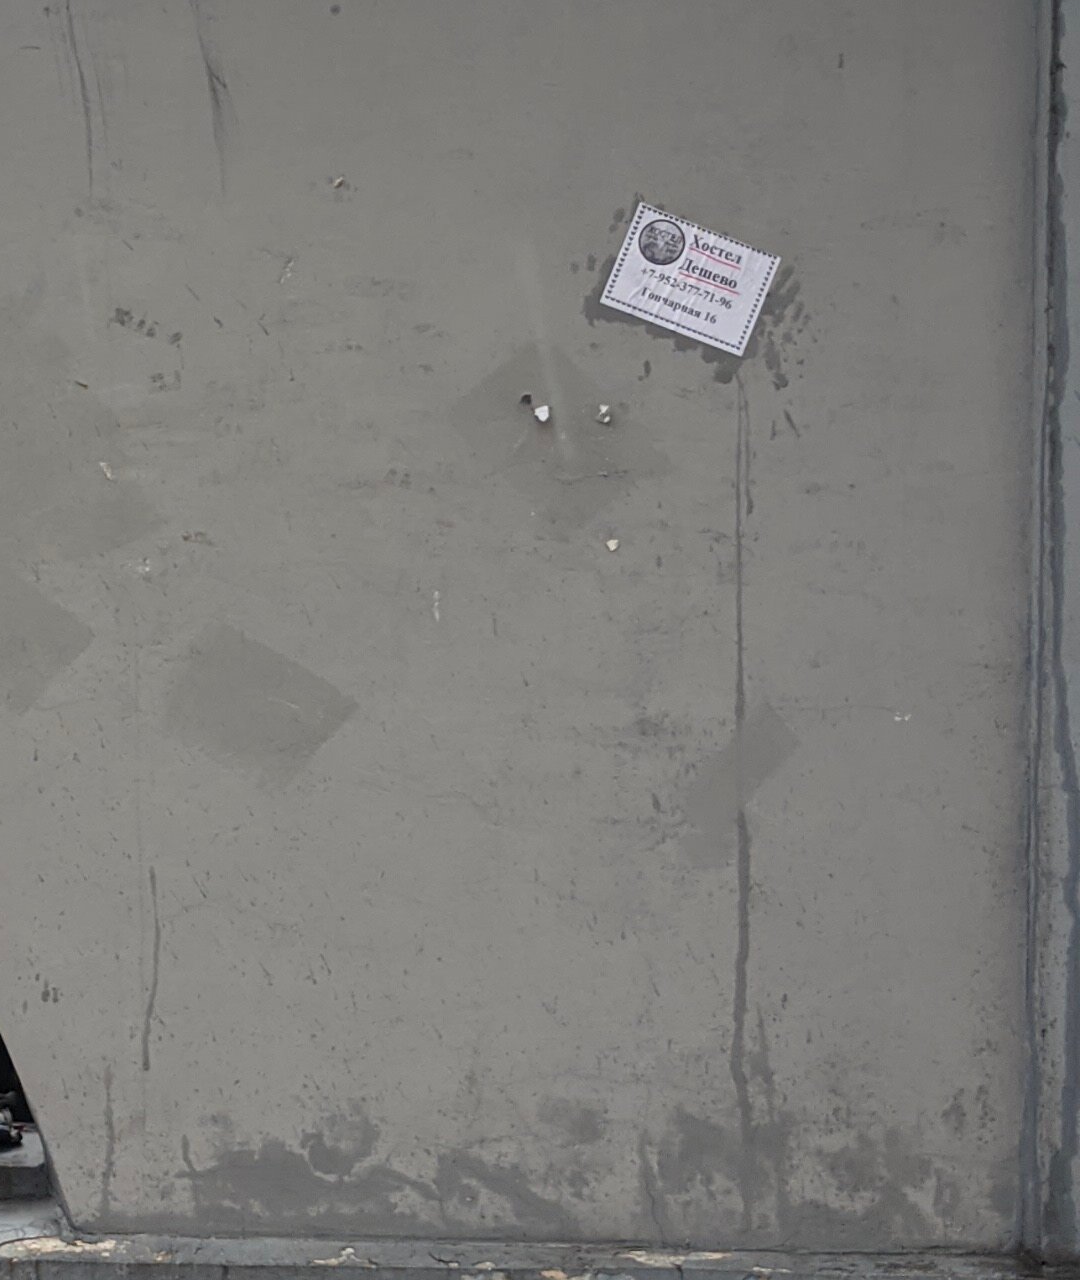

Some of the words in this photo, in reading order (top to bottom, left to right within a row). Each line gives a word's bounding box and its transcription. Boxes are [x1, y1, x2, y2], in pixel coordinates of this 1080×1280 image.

[689, 234, 742, 265] Хостел
[640, 267, 732, 311] +7-952-377-71-96
[678, 257, 738, 290] Дешево
[641, 286, 701, 319] Гончарная
[704, 311, 718, 325] 16
